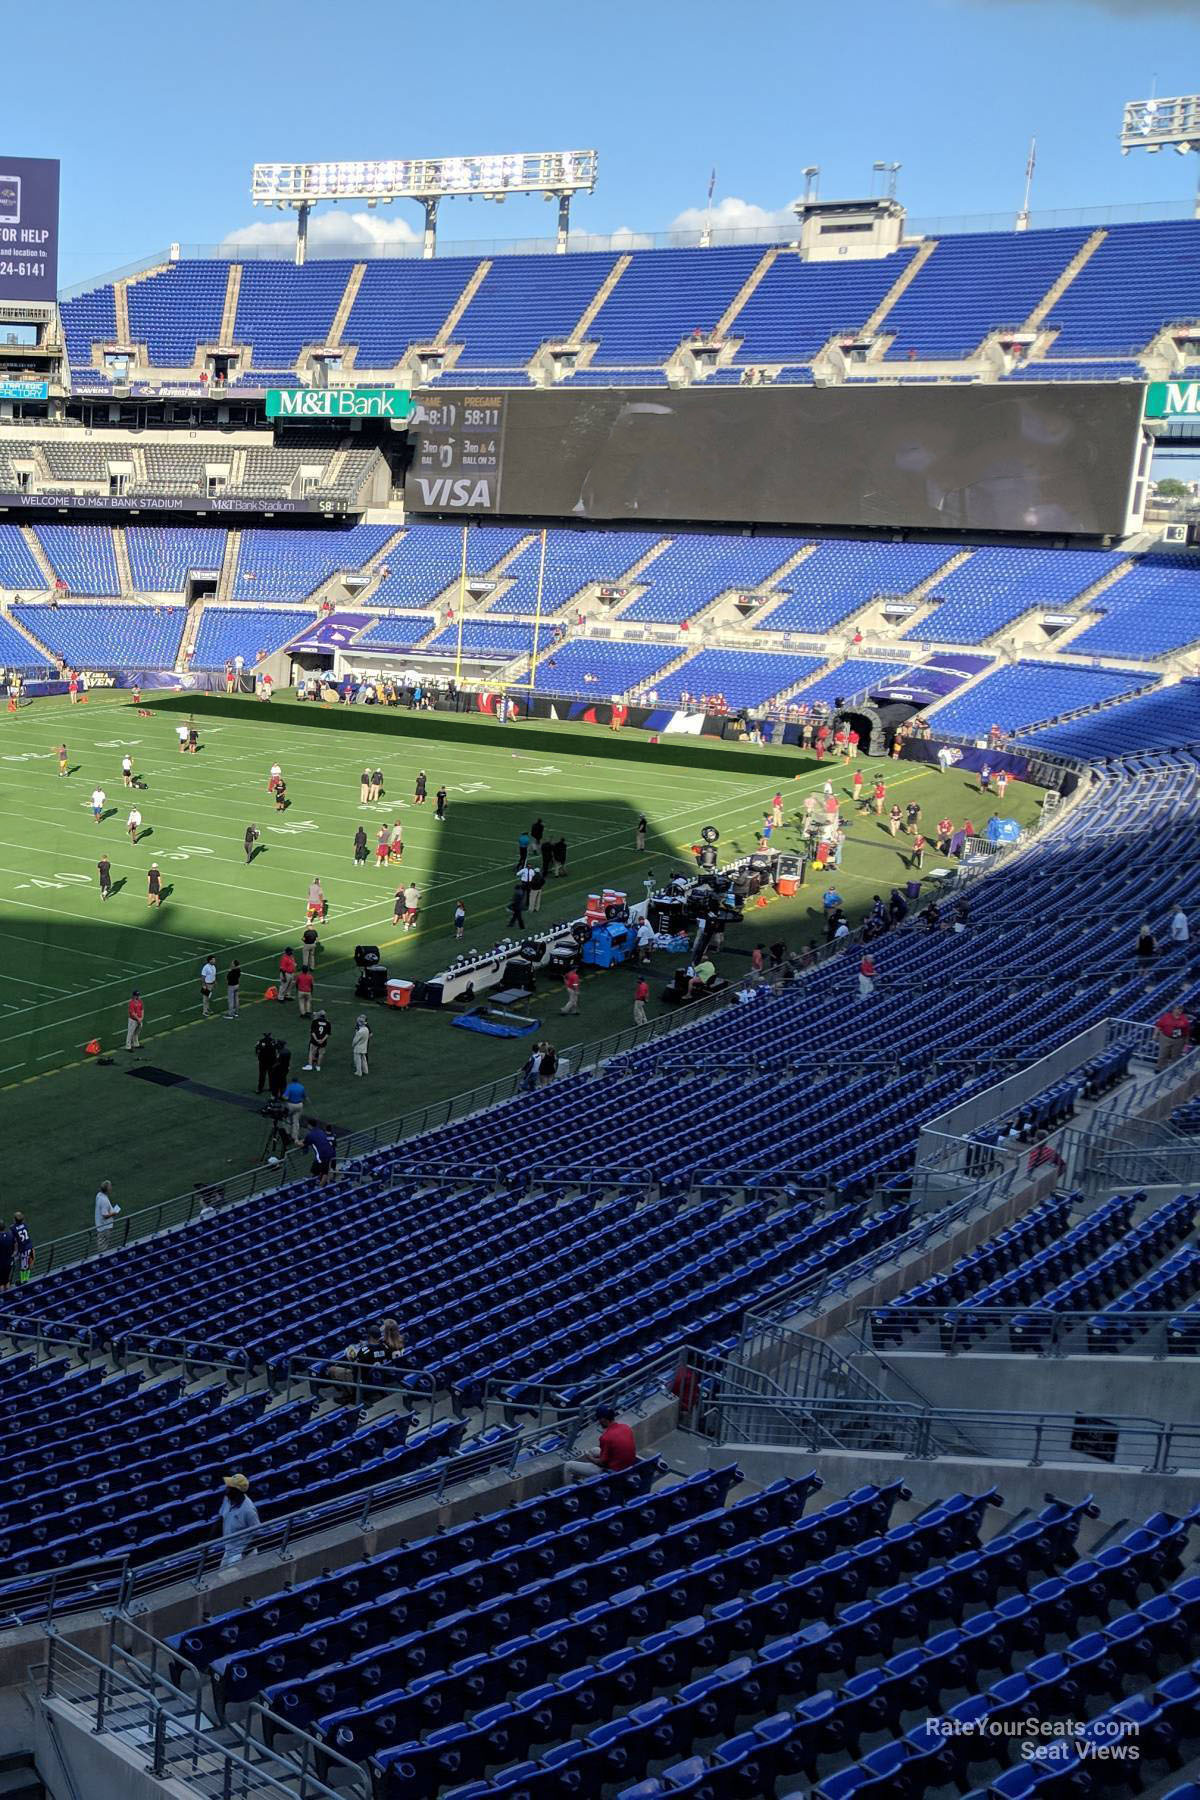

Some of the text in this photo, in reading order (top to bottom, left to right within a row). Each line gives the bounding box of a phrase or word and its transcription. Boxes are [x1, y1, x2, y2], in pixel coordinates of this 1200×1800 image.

[21, 229, 49, 243] HELP
[0, 247, 12, 256] and
[13, 248, 38, 257] location
[279, 390, 394, 415] M&T Bank
[464, 396, 503, 407] PREGAME
[464, 409, 498, 425] 58:11
[415, 478, 491, 507] VISA
[21, 496, 183, 508] WELCOME TO M&T BANK STADIUM
[211, 500, 294, 511] M&T Bank Stadium
[319, 502, 347, 511] 58:11
